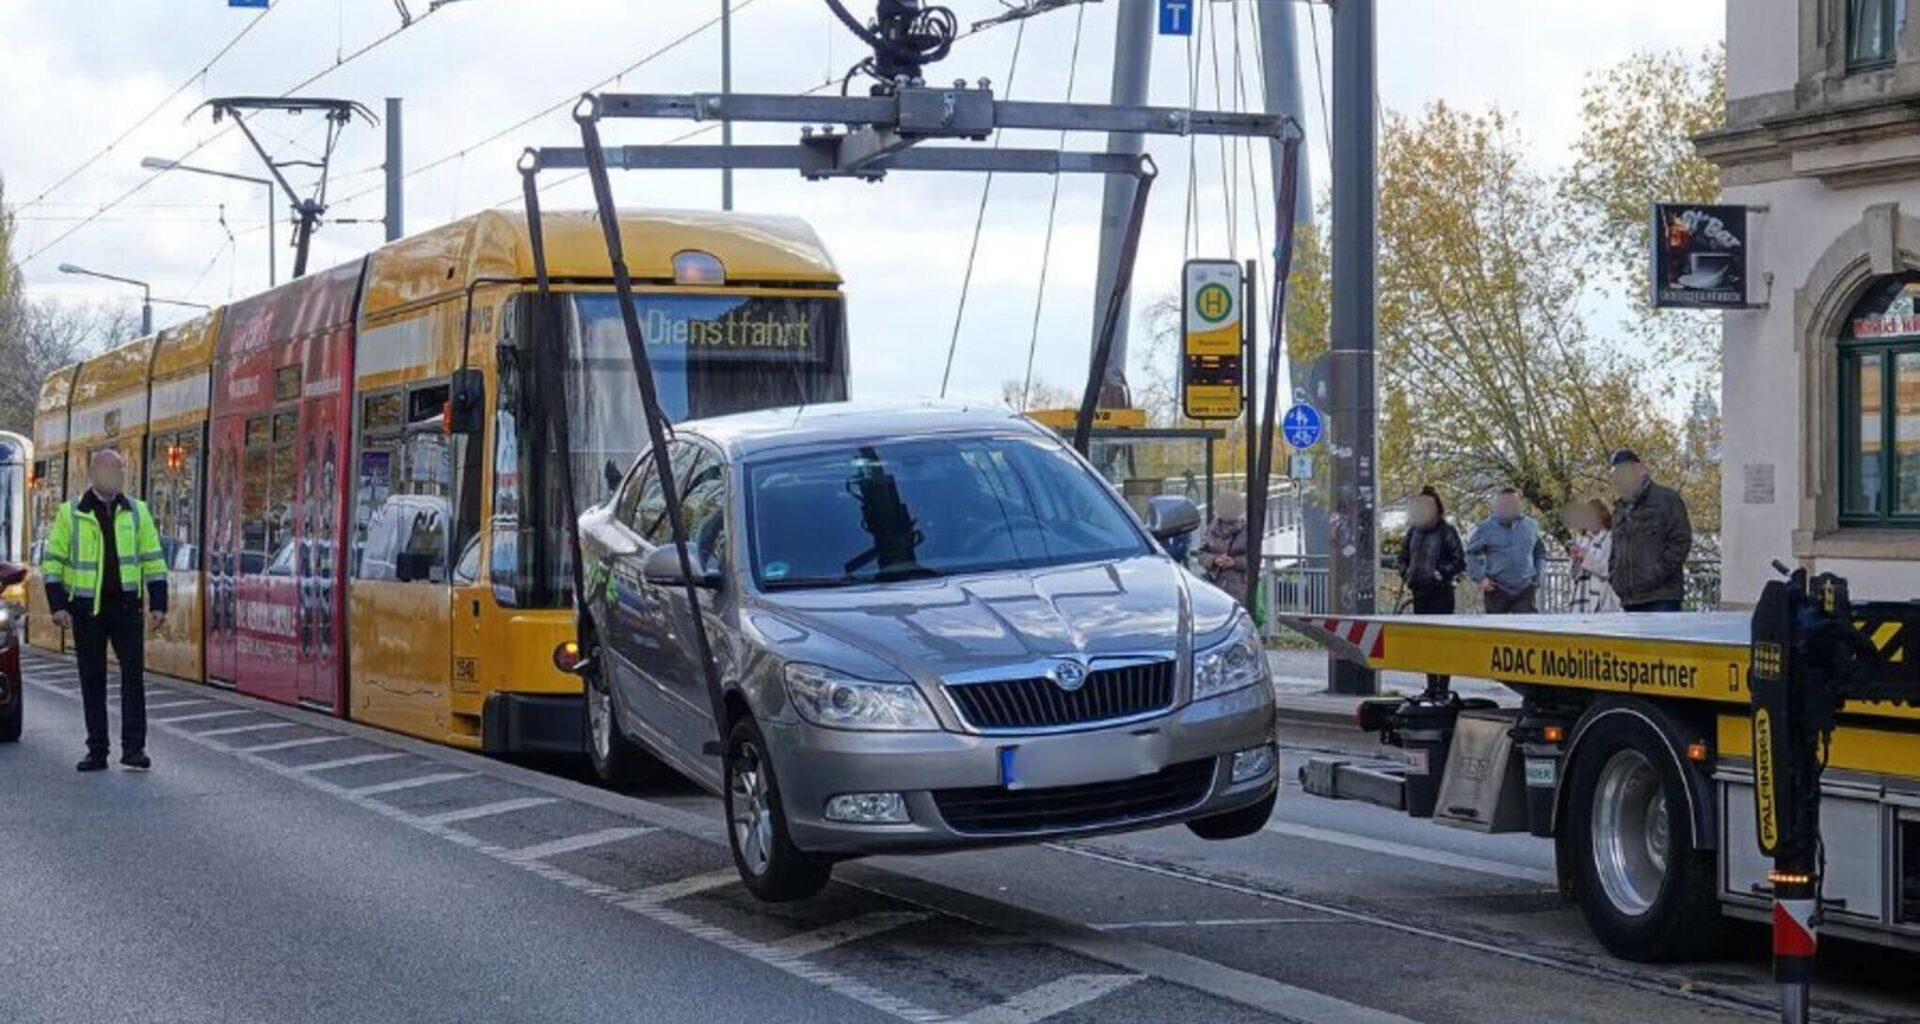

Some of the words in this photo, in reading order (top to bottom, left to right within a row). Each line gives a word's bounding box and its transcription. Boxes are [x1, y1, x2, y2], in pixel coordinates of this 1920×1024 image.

[1166, 4, 1186, 30] T
[1205, 291, 1222, 315] H
[646, 309, 809, 347] Dienstfahrt
[1490, 646, 1537, 675] ADAC
[1541, 650, 1698, 691] Mobilitätspartner
[1757, 717, 1775, 840] PALFINGER
